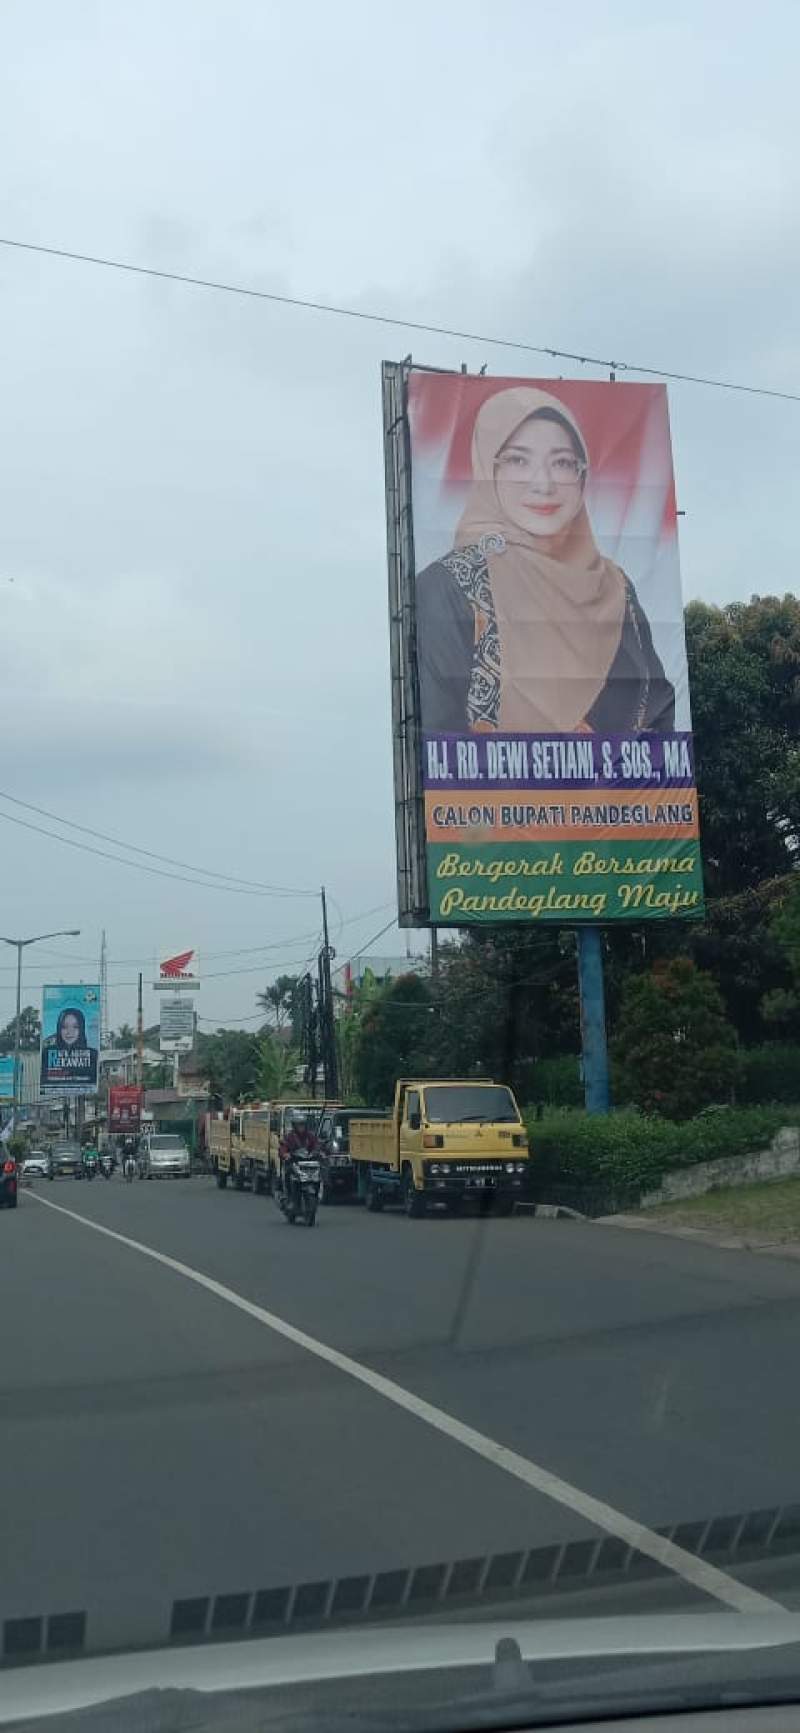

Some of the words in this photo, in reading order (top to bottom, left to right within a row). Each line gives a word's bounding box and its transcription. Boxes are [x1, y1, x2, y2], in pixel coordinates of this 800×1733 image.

[426, 741, 453, 779] HJ.
[456, 741, 483, 779] RD.
[487, 741, 529, 779] DEWI
[532, 741, 598, 781] SETIANI,
[602, 741, 617, 779] S.
[620, 741, 661, 781] SOS.,
[663, 741, 692, 778] MA
[432, 805, 495, 828] CALON
[501, 804, 565, 826] BUPATI
[571, 803, 694, 826] PANDEGLANG
[436, 853, 564, 882] Bergerak
[572, 851, 695, 876] Bersama
[439, 884, 607, 916] Pandeglang
[617, 884, 700, 913] Maju
